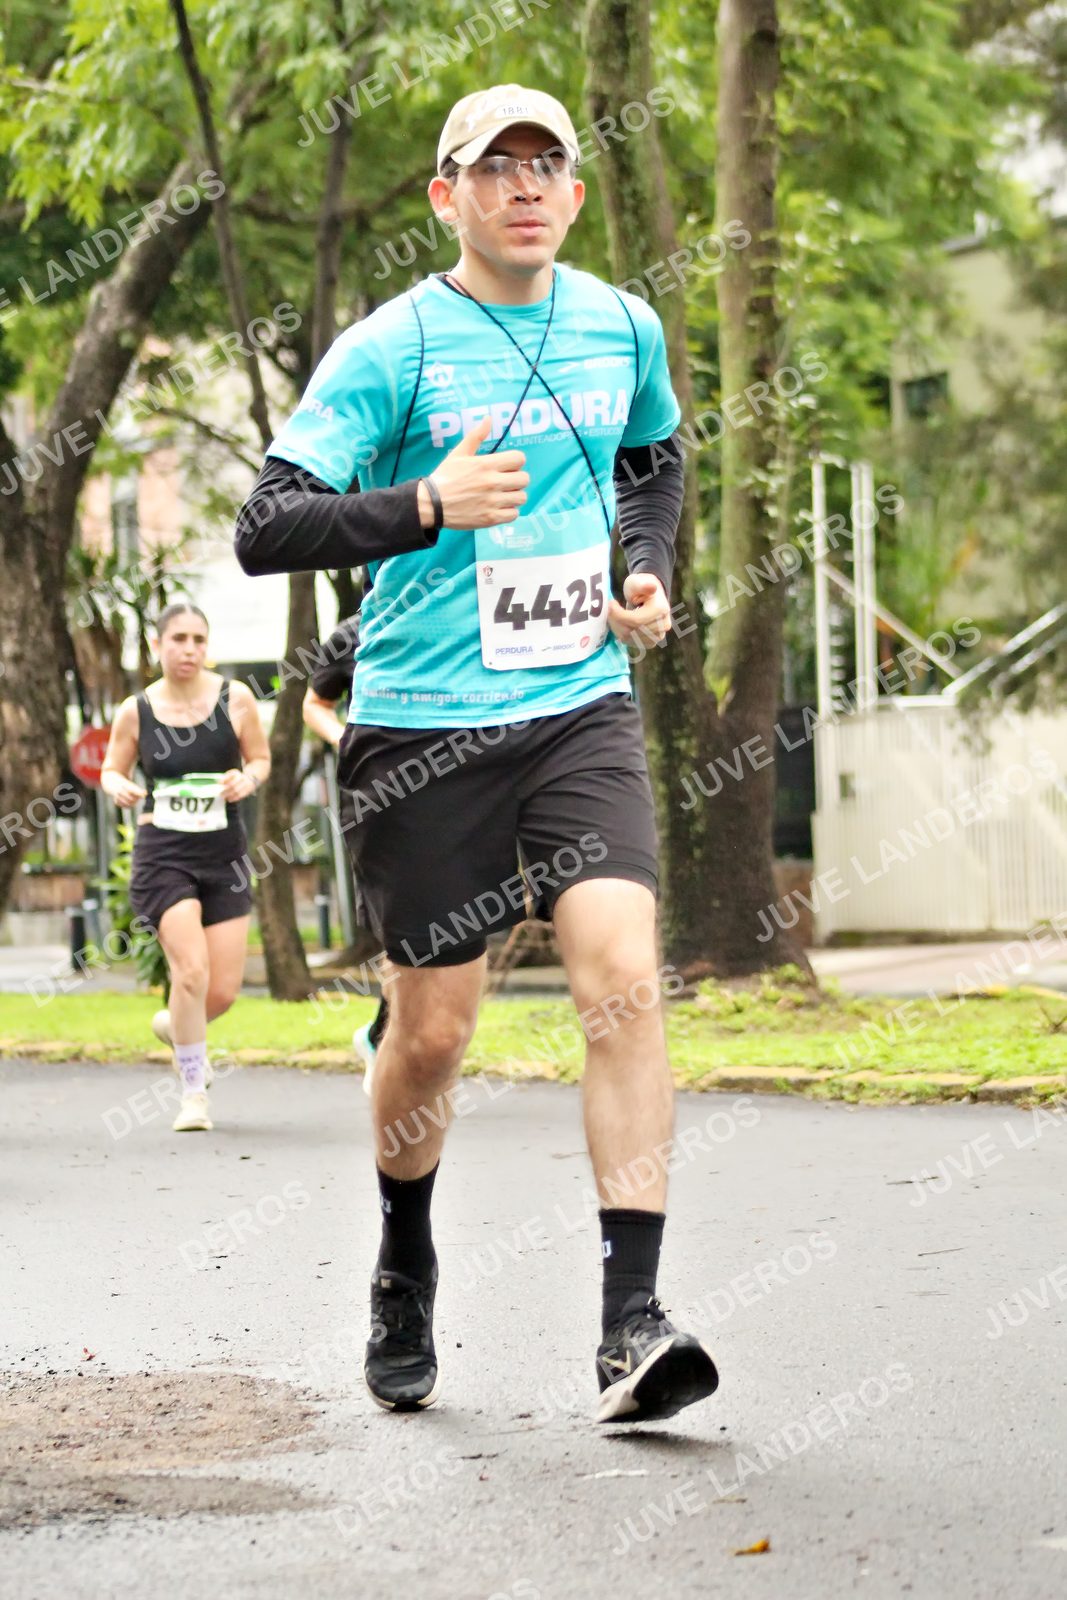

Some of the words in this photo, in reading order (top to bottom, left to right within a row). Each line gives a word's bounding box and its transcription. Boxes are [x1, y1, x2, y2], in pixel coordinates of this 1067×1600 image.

[427, 388, 630, 448] PERDURA
[493, 571, 604, 631] 4425
[495, 645, 533, 655] PERDURA
[400, 692, 409, 705] y
[411, 691, 458, 707] amigos
